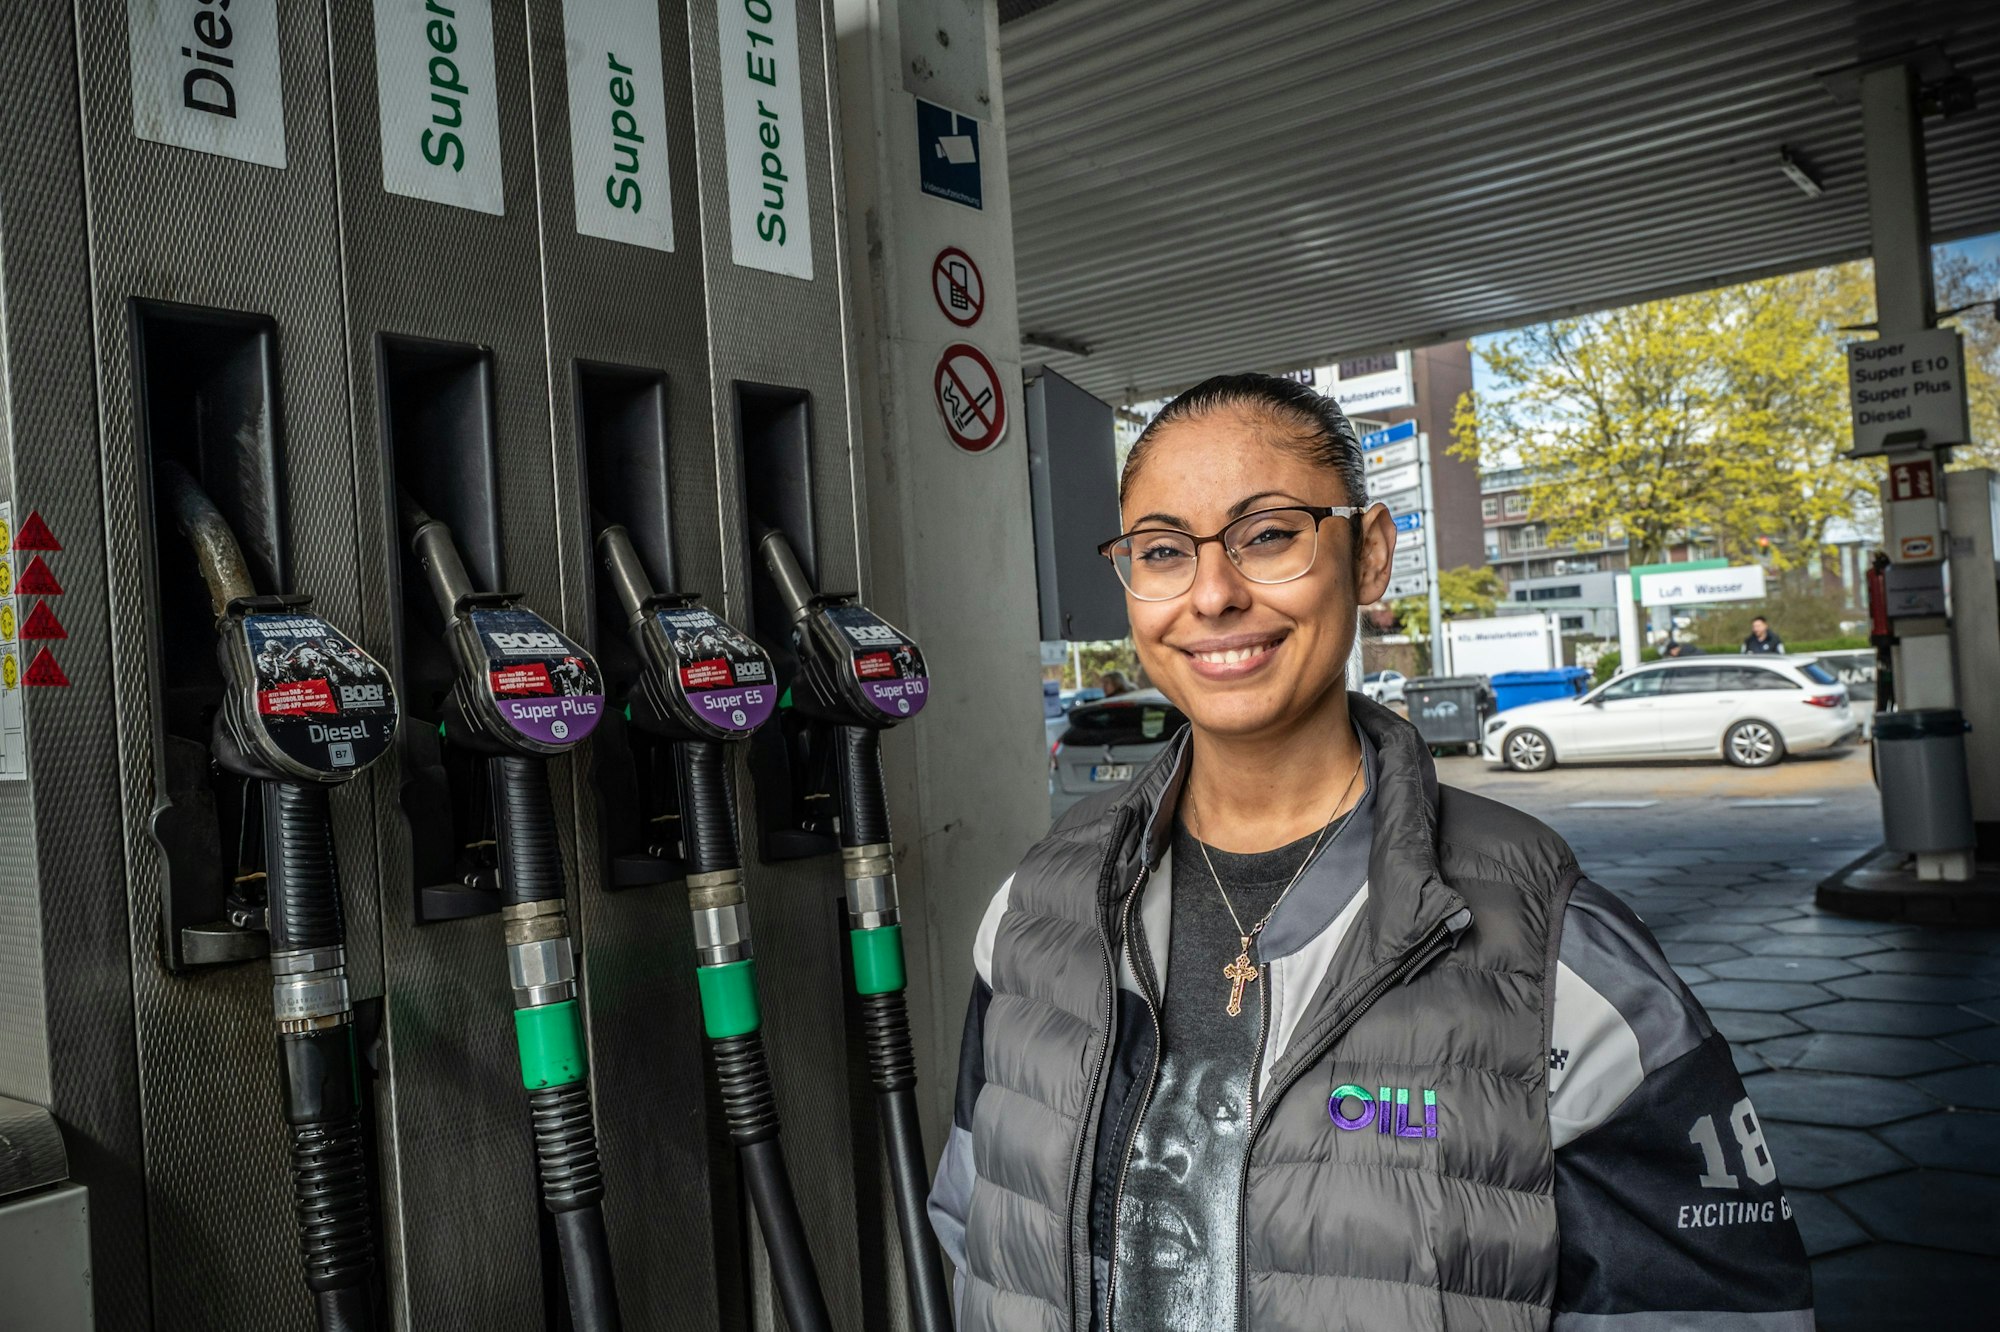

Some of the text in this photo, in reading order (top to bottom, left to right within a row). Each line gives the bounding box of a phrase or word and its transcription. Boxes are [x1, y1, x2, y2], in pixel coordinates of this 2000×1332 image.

[605, 52, 645, 214] Super
[744, 0, 789, 247] Super E10
[1854, 343, 1905, 362] Super
[1856, 356, 1949, 383] Super E10
[1340, 385, 1402, 404] Autoservice
[1857, 381, 1952, 404] Super Plus
[1858, 405, 1912, 425] Diesel
[1659, 583, 1742, 598] Luft Wasser
[254, 619, 326, 630] WENN ROCK,
[261, 627, 327, 638] DANN BOB!
[691, 618, 717, 628] BOB!
[844, 625, 897, 640] BOB!
[488, 632, 564, 649] BOB!
[734, 661, 765, 676] BOB!
[340, 684, 384, 701] BOB!
[873, 681, 925, 700] Super E10
[703, 690, 763, 712] Super E5
[511, 699, 597, 723] Super Plus
[735, 714, 744, 722] E5
[308, 720, 370, 743] Diesel
[554, 725, 566, 734] E5
[335, 749, 348, 759] B7
[1688, 1096, 1776, 1189] 18
[1677, 1195, 1793, 1229] EXCITING G
